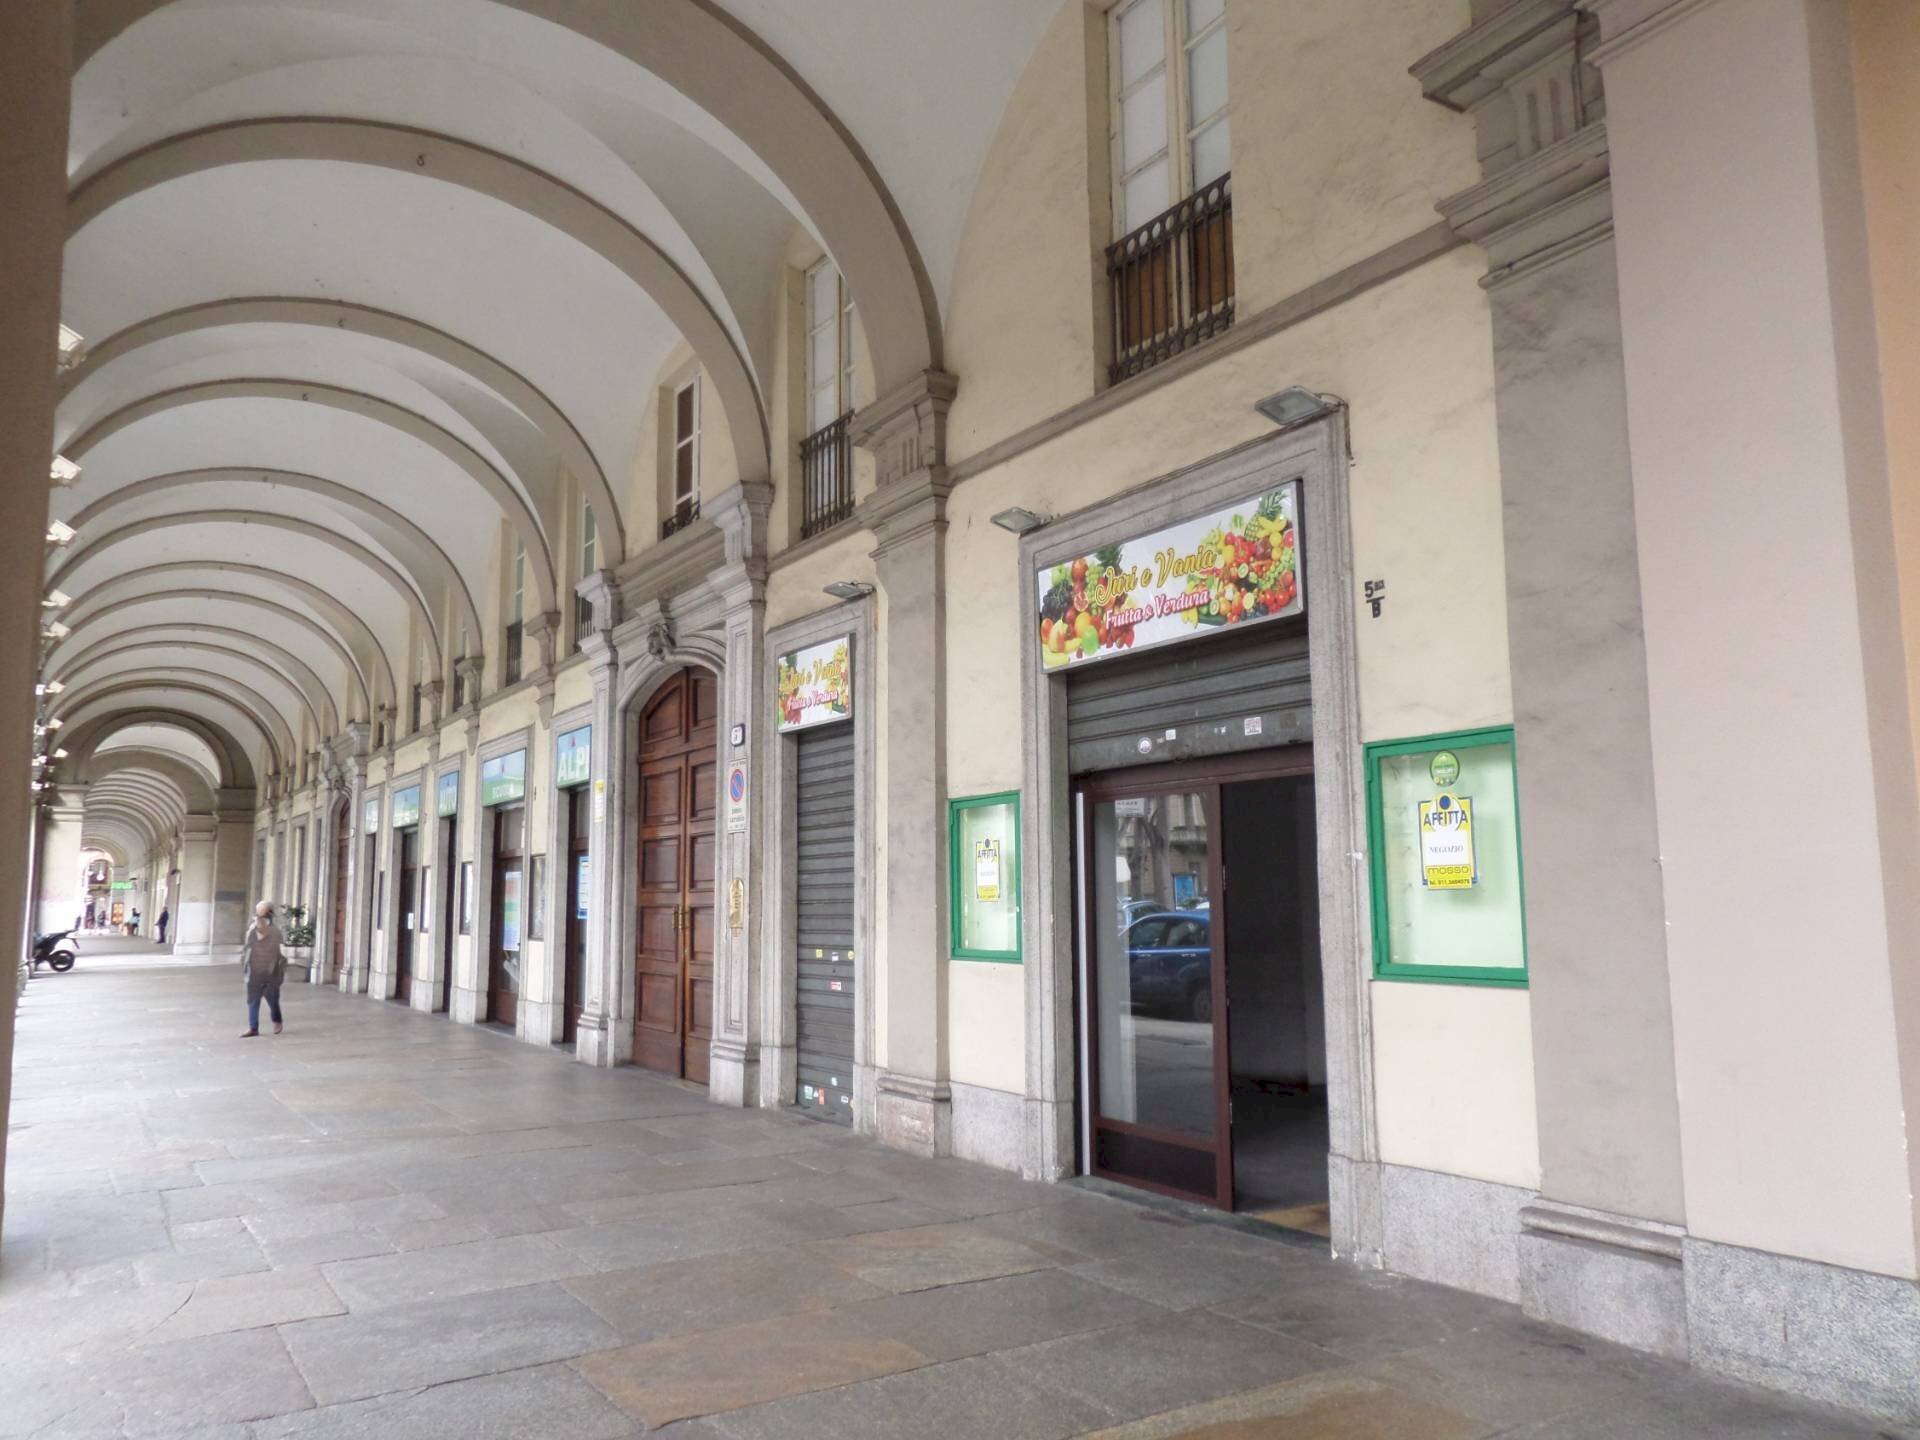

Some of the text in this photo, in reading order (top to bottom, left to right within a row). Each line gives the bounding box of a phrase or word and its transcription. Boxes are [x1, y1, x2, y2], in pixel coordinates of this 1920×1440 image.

[1141, 568, 1152, 588] e
[1155, 545, 1217, 588] Vania
[1105, 607, 1144, 630] Frutta
[1154, 590, 1211, 618] Verdura
[1372, 600, 1381, 619] B
[1423, 810, 1468, 826] AFFITTA
[1429, 845, 1464, 854] NEGOZIO
